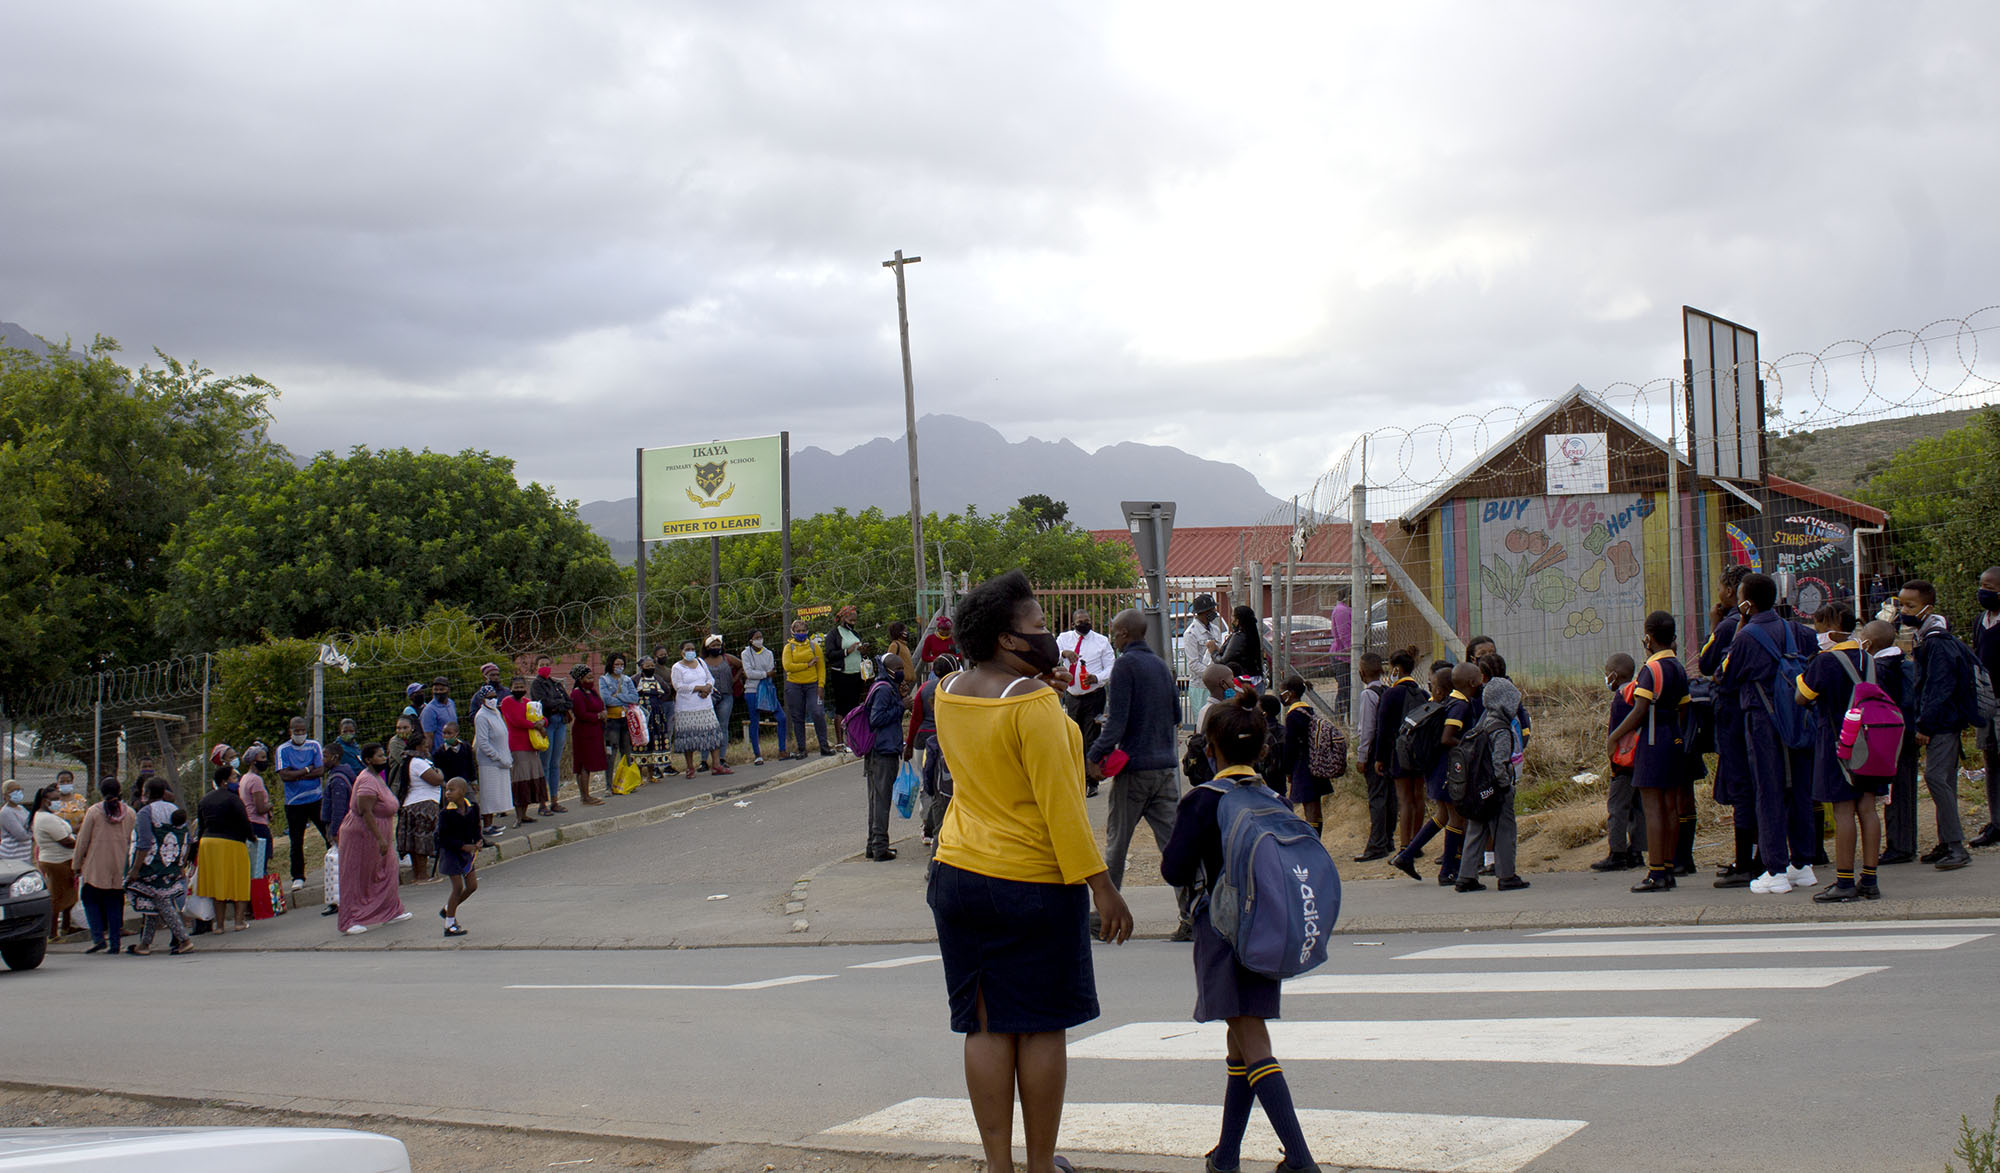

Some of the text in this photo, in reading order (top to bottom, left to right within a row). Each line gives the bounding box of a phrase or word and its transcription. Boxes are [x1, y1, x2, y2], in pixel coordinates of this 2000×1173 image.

[693, 445, 728, 458] IKAYA
[1482, 498, 1530, 523] BUY
[663, 517, 760, 534] ENTER TO LEARN
[1300, 883, 1320, 964] adidas
